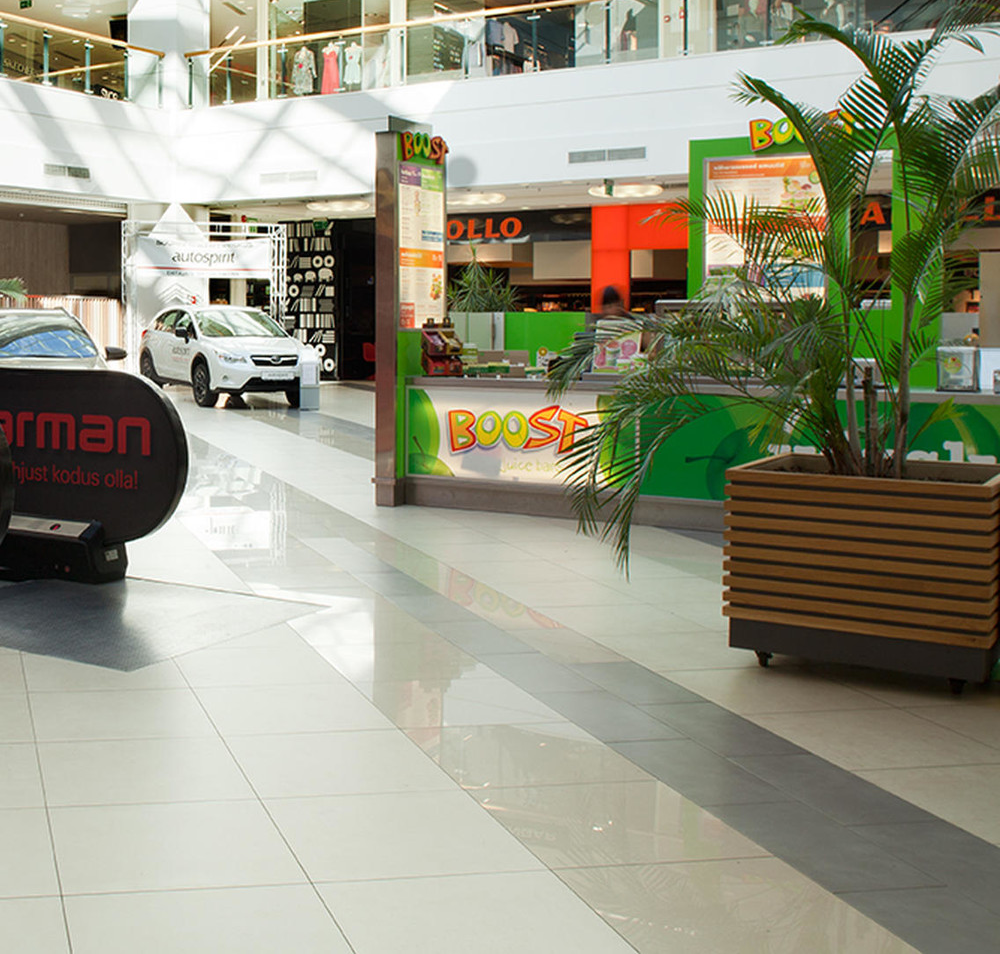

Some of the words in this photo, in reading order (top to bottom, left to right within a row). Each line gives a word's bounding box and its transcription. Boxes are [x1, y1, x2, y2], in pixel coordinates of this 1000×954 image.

[400, 131, 449, 165] BOOST
[448, 405, 589, 454] BOOST
[52, 464, 100, 486] kodus
[104, 468, 138, 490] olla!
